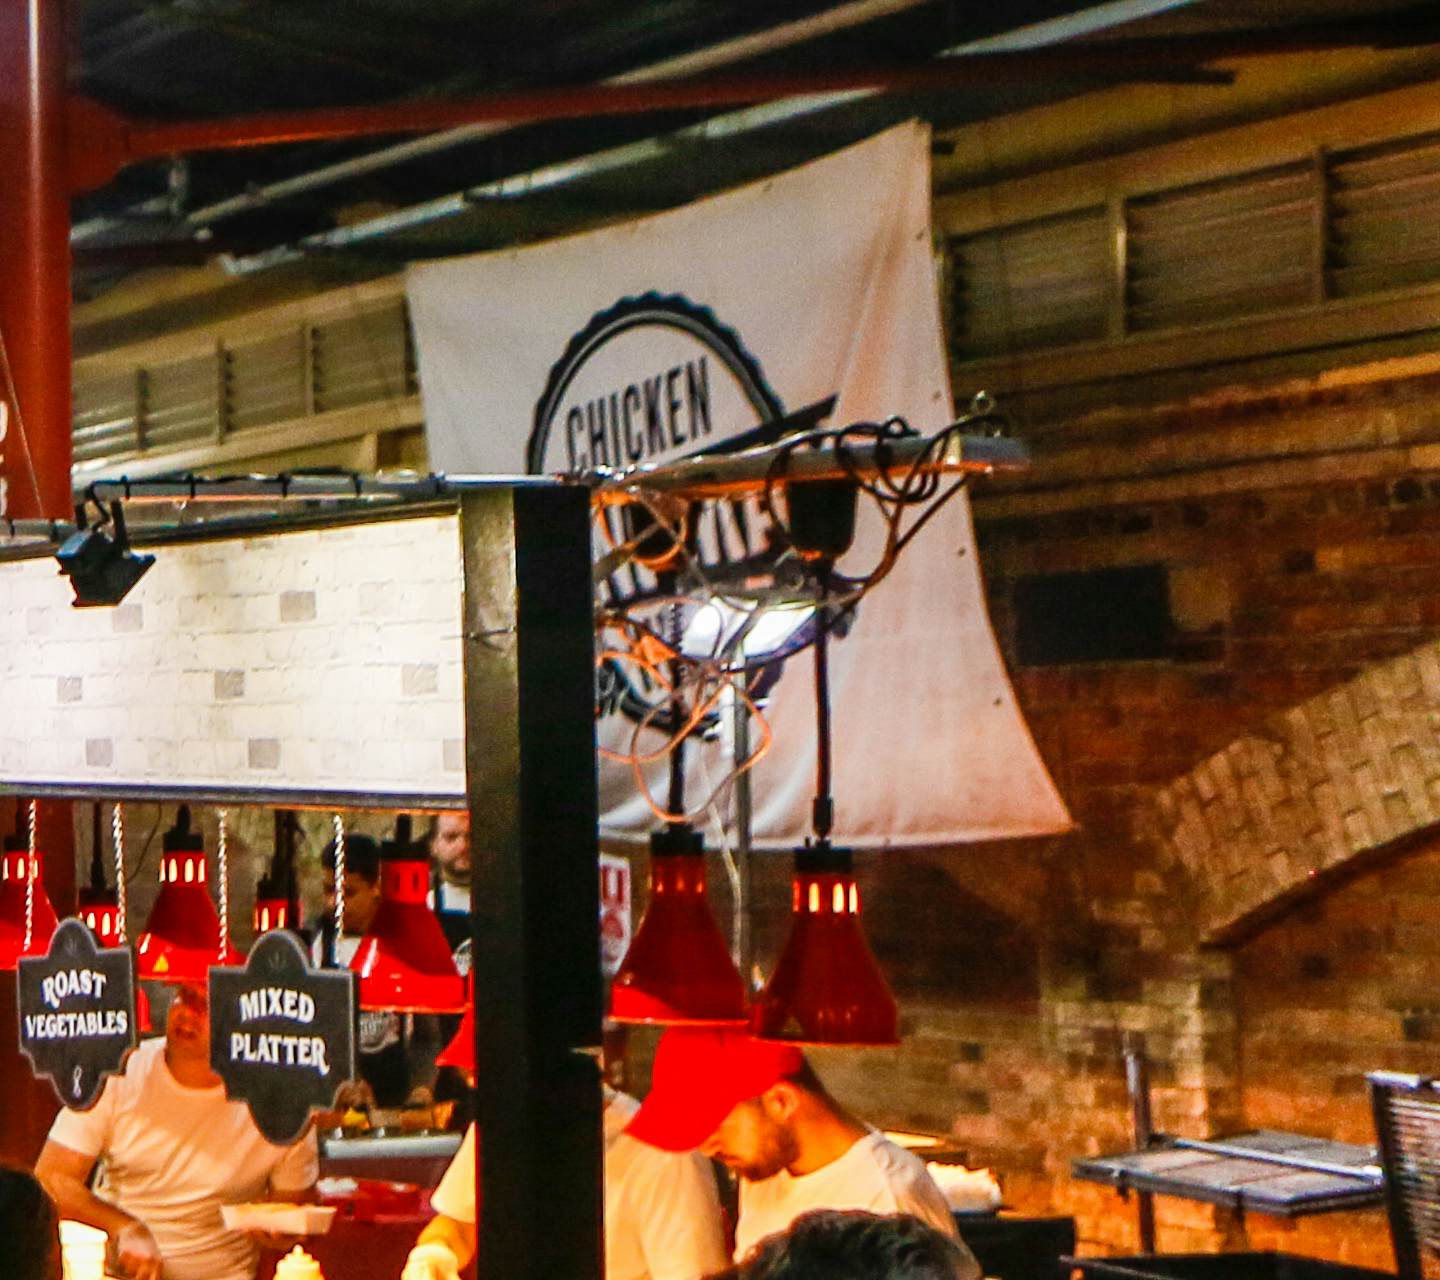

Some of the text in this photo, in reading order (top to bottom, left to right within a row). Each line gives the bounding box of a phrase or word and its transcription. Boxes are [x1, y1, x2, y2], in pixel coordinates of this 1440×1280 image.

[567, 357, 711, 477] CHICKEN
[42, 969, 107, 1008] ROAST
[239, 986, 317, 1025] MIXED
[25, 1010, 128, 1038] VEGETABLES
[230, 1032, 330, 1077] PLATTER
